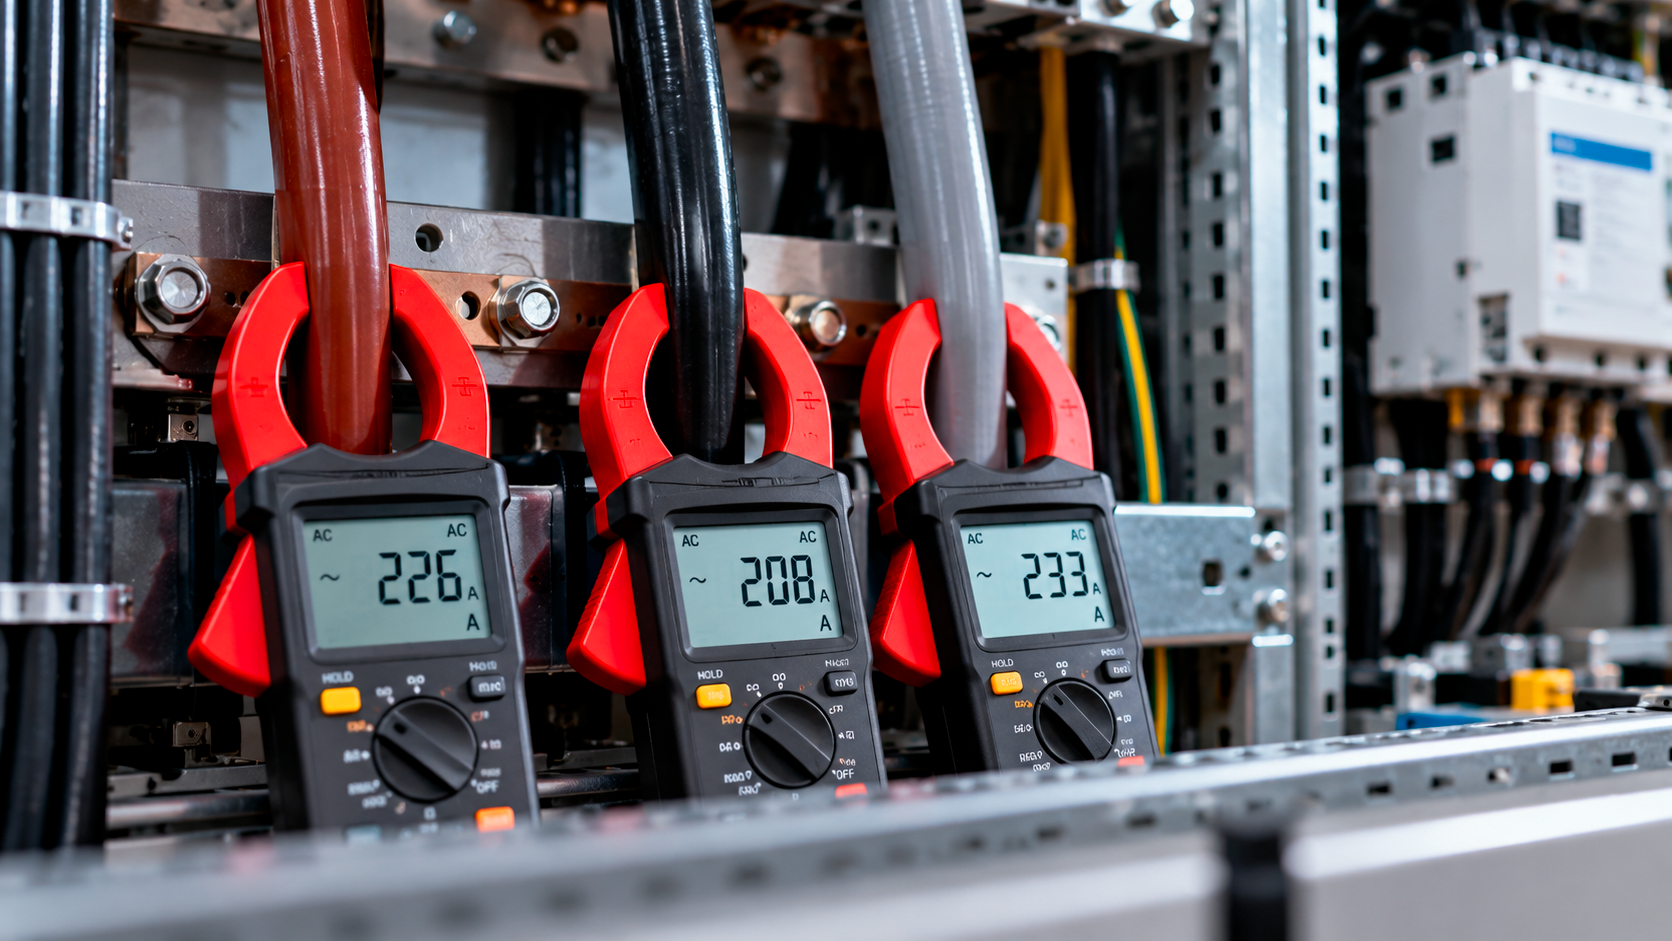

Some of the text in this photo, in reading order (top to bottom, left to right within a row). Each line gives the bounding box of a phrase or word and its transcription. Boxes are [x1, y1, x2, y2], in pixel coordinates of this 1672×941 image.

[312, 523, 467, 542] AC AC
[682, 530, 817, 547] AC AC
[967, 528, 1086, 544] AC AC
[378, 549, 479, 605] 226 A
[740, 554, 830, 607] 208 A
[1021, 551, 1101, 600] 233 A
[467, 613, 480, 631] A
[1094, 606, 1105, 622] A
[820, 614, 832, 632] A
[991, 658, 1014, 668] HOLD
[321, 670, 354, 684] HOLD
[697, 669, 723, 680] HOLD
[836, 768, 855, 780] OFF
[476, 780, 499, 794] OFF
